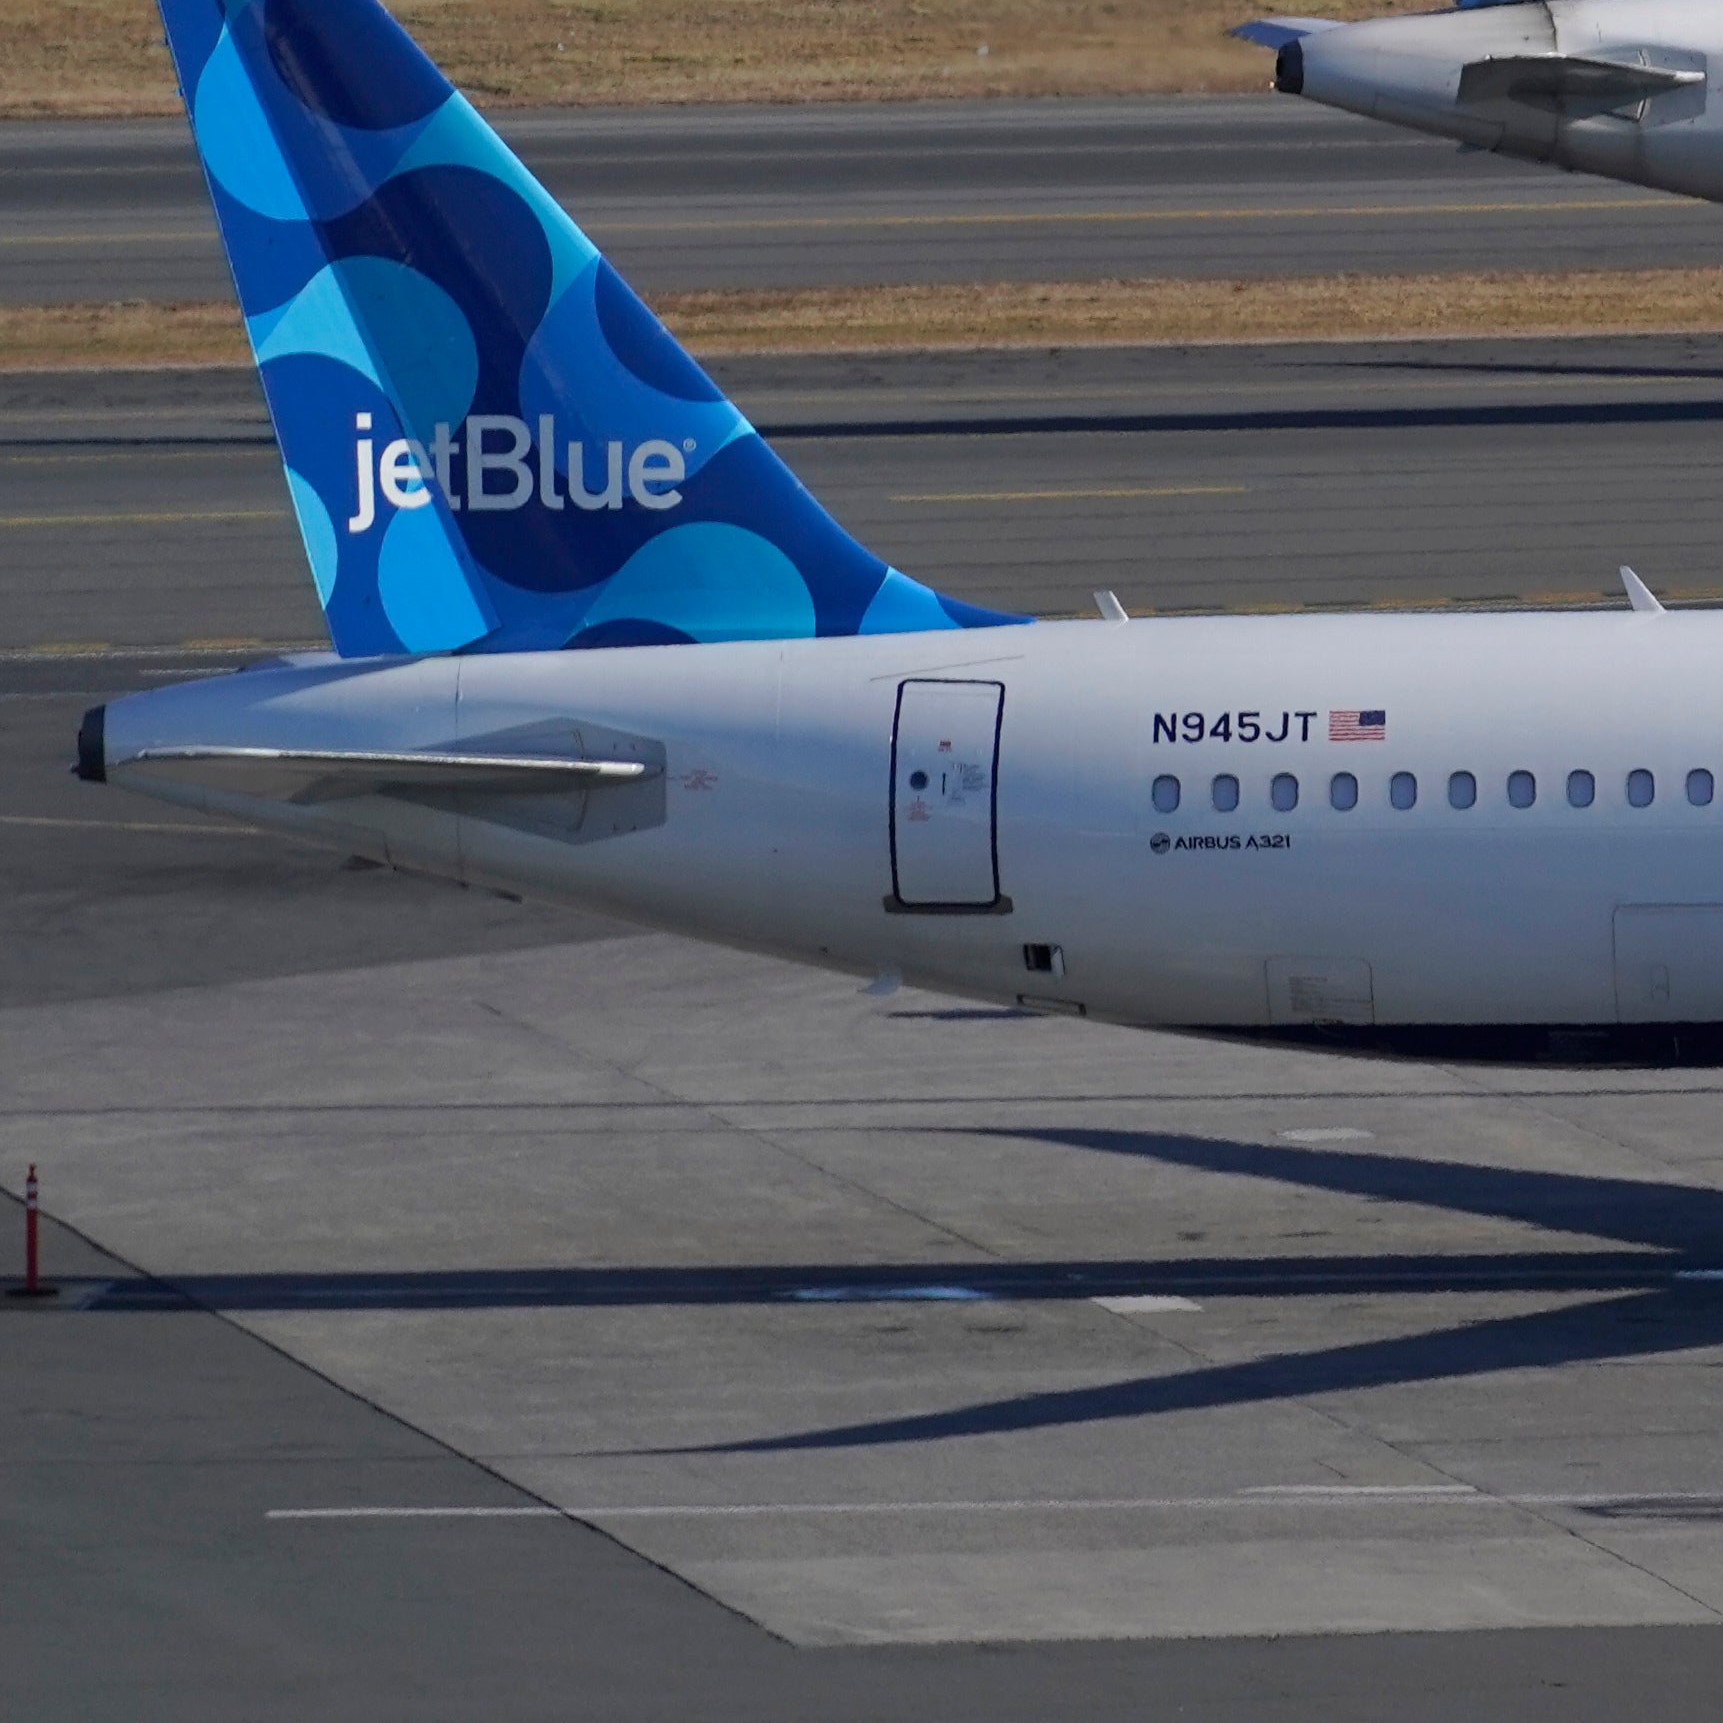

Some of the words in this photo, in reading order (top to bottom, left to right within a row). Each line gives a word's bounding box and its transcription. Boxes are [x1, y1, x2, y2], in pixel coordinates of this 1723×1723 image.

[349, 412, 686, 533] jetBlue
[1153, 711, 1317, 744] N945JT
[1174, 835, 1241, 850] AIRBUS
[1245, 834, 1291, 851] A321
